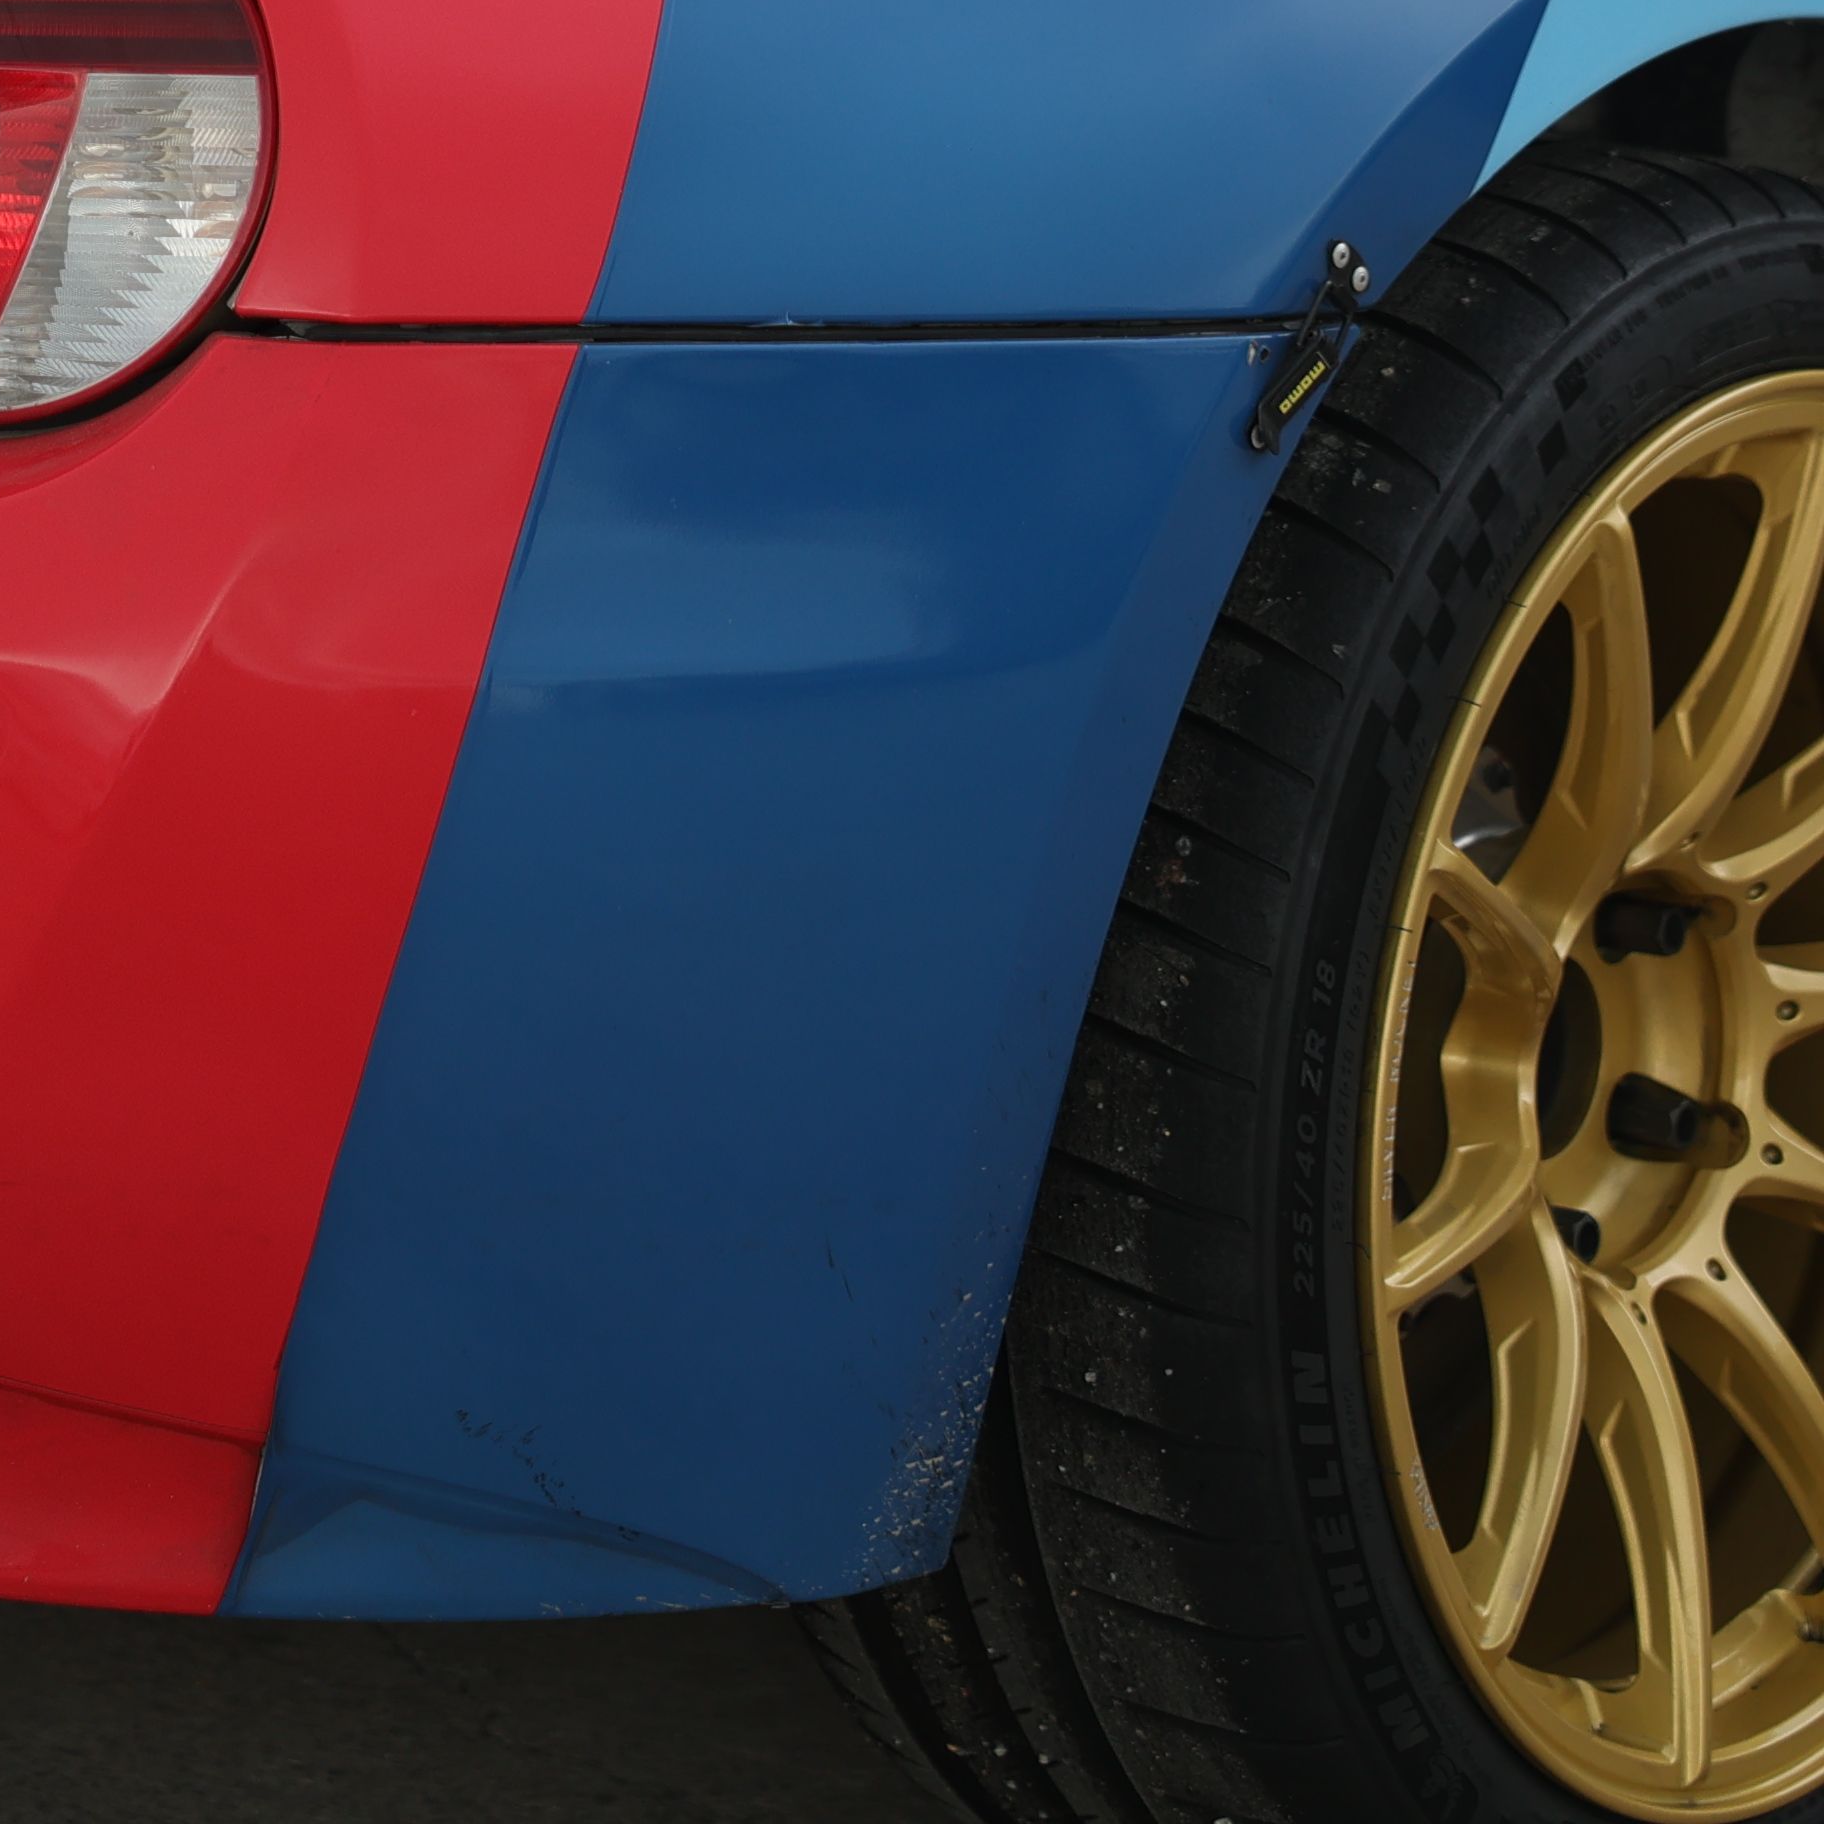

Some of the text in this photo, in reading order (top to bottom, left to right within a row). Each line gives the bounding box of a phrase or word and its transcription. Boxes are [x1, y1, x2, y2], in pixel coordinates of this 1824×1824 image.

[1294, 960, 1337, 1298] 225/40 ZR 18
[1291, 1350, 1429, 1752] MICHELIN
